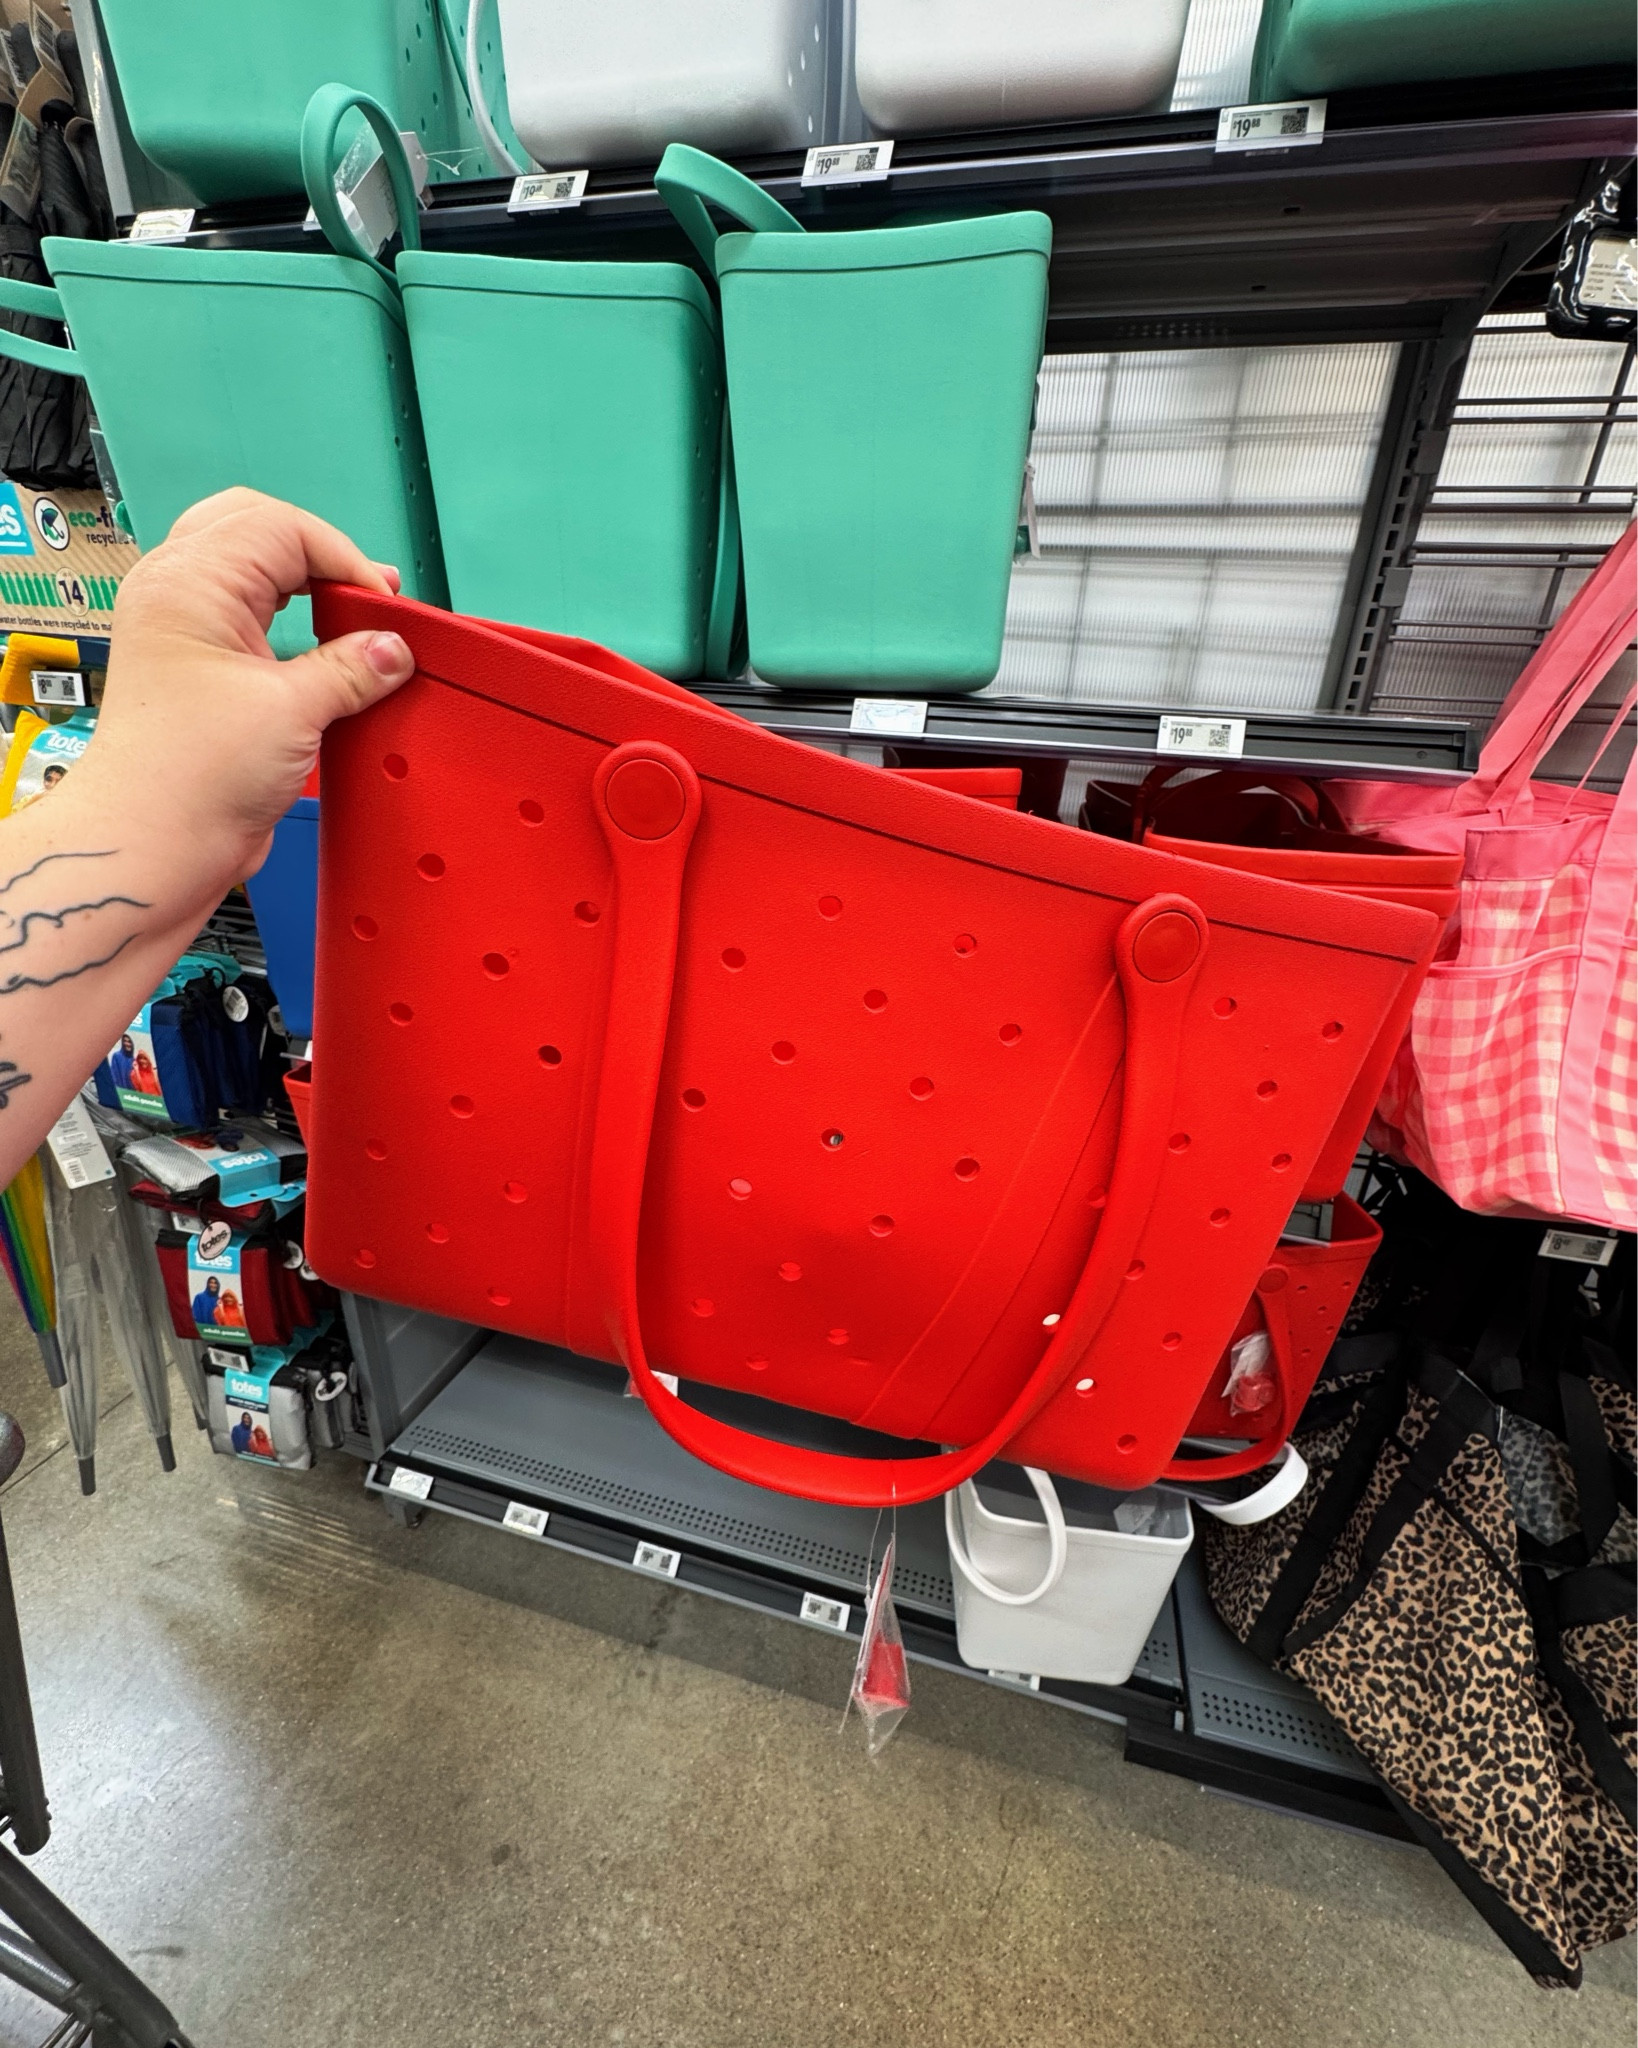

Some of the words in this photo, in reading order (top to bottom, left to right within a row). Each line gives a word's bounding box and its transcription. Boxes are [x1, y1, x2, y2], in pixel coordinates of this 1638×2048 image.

[59, 580, 85, 606] 14
[18, 616, 42, 627] bottles
[43, 619, 60, 628] were
[61, 619, 91, 631] recycled
[101, 623, 113, 632] ma
[201, 1229, 229, 1252] totes
[231, 1378, 263, 1397] totes
